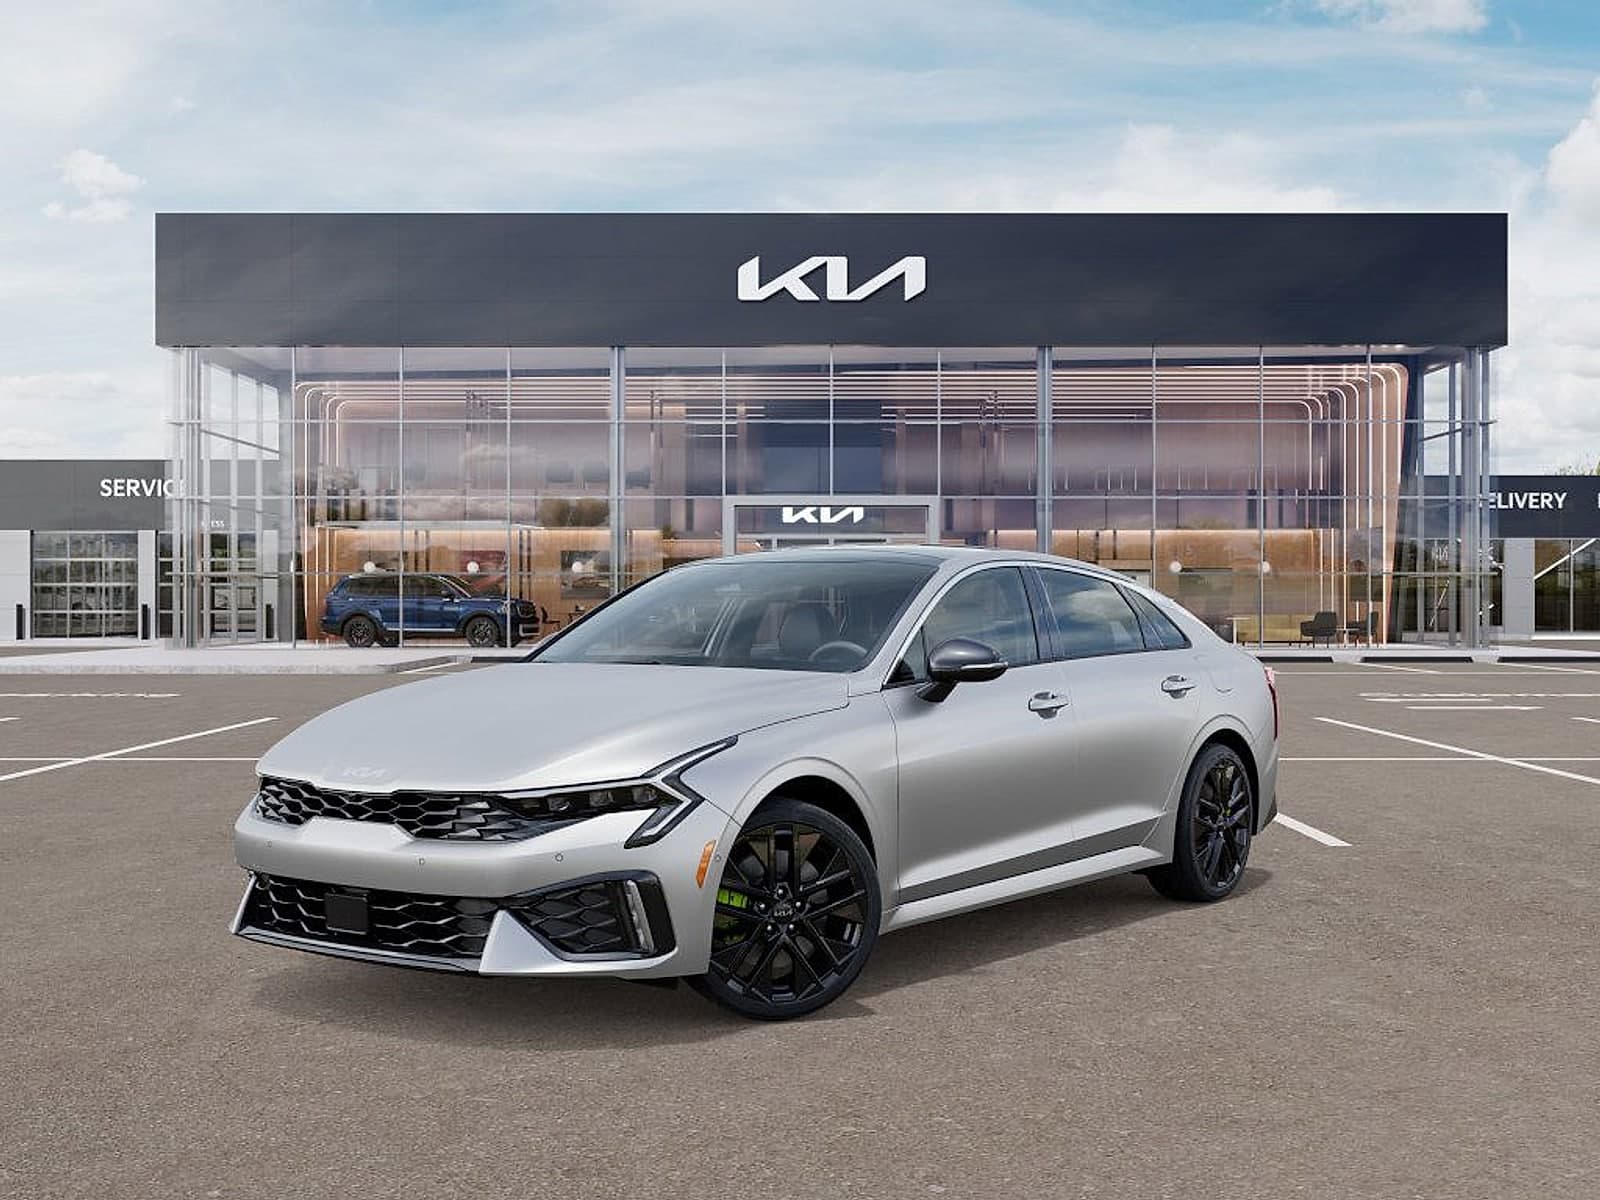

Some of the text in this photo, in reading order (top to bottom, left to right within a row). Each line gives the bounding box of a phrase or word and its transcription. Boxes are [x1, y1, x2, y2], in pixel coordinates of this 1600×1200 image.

[738, 256, 926, 301] KIA
[100, 479, 186, 497] SERVIC
[1479, 492, 1568, 509] ELIVERY
[782, 506, 864, 523] KIA
